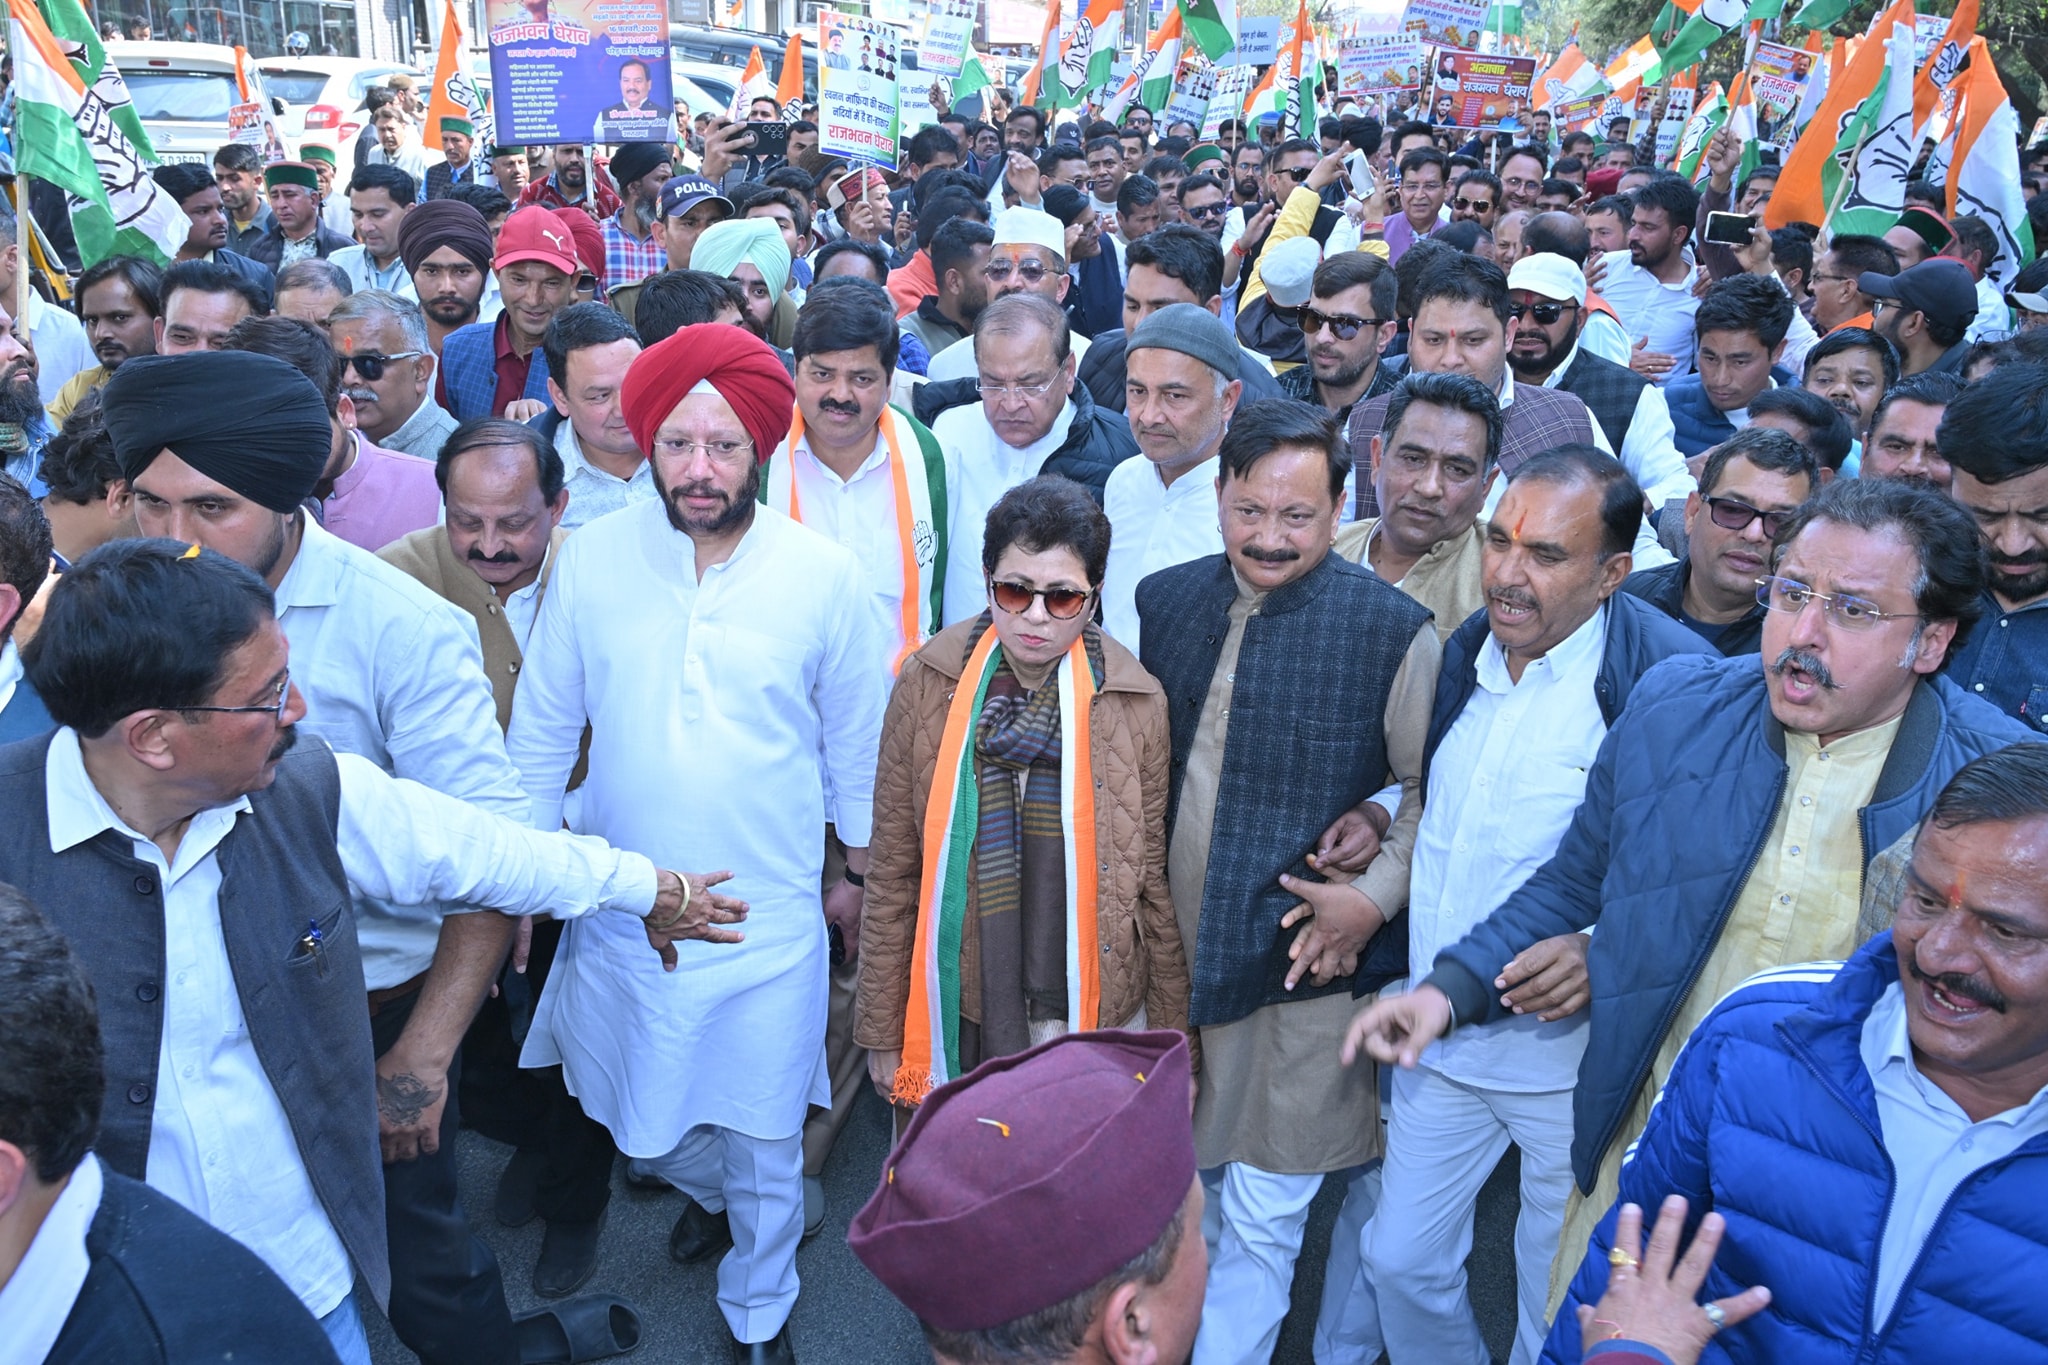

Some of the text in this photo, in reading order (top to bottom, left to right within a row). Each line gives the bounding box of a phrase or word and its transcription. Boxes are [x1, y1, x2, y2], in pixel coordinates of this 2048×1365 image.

[491, 22, 590, 45] राजभवन घेराव
[1470, 62, 1507, 76] अत्याचार
[1463, 81, 1528, 98] राजभवन घेराव
[1761, 74, 1798, 95] राजभवन
[1761, 90, 1787, 104] घेराव
[870, 96, 877, 109] की
[878, 102, 896, 118] सरकार
[860, 110, 866, 122] है
[828, 124, 873, 146] राजभवन
[874, 131, 894, 154] घेराव
[674, 182, 718, 199] POLICE
